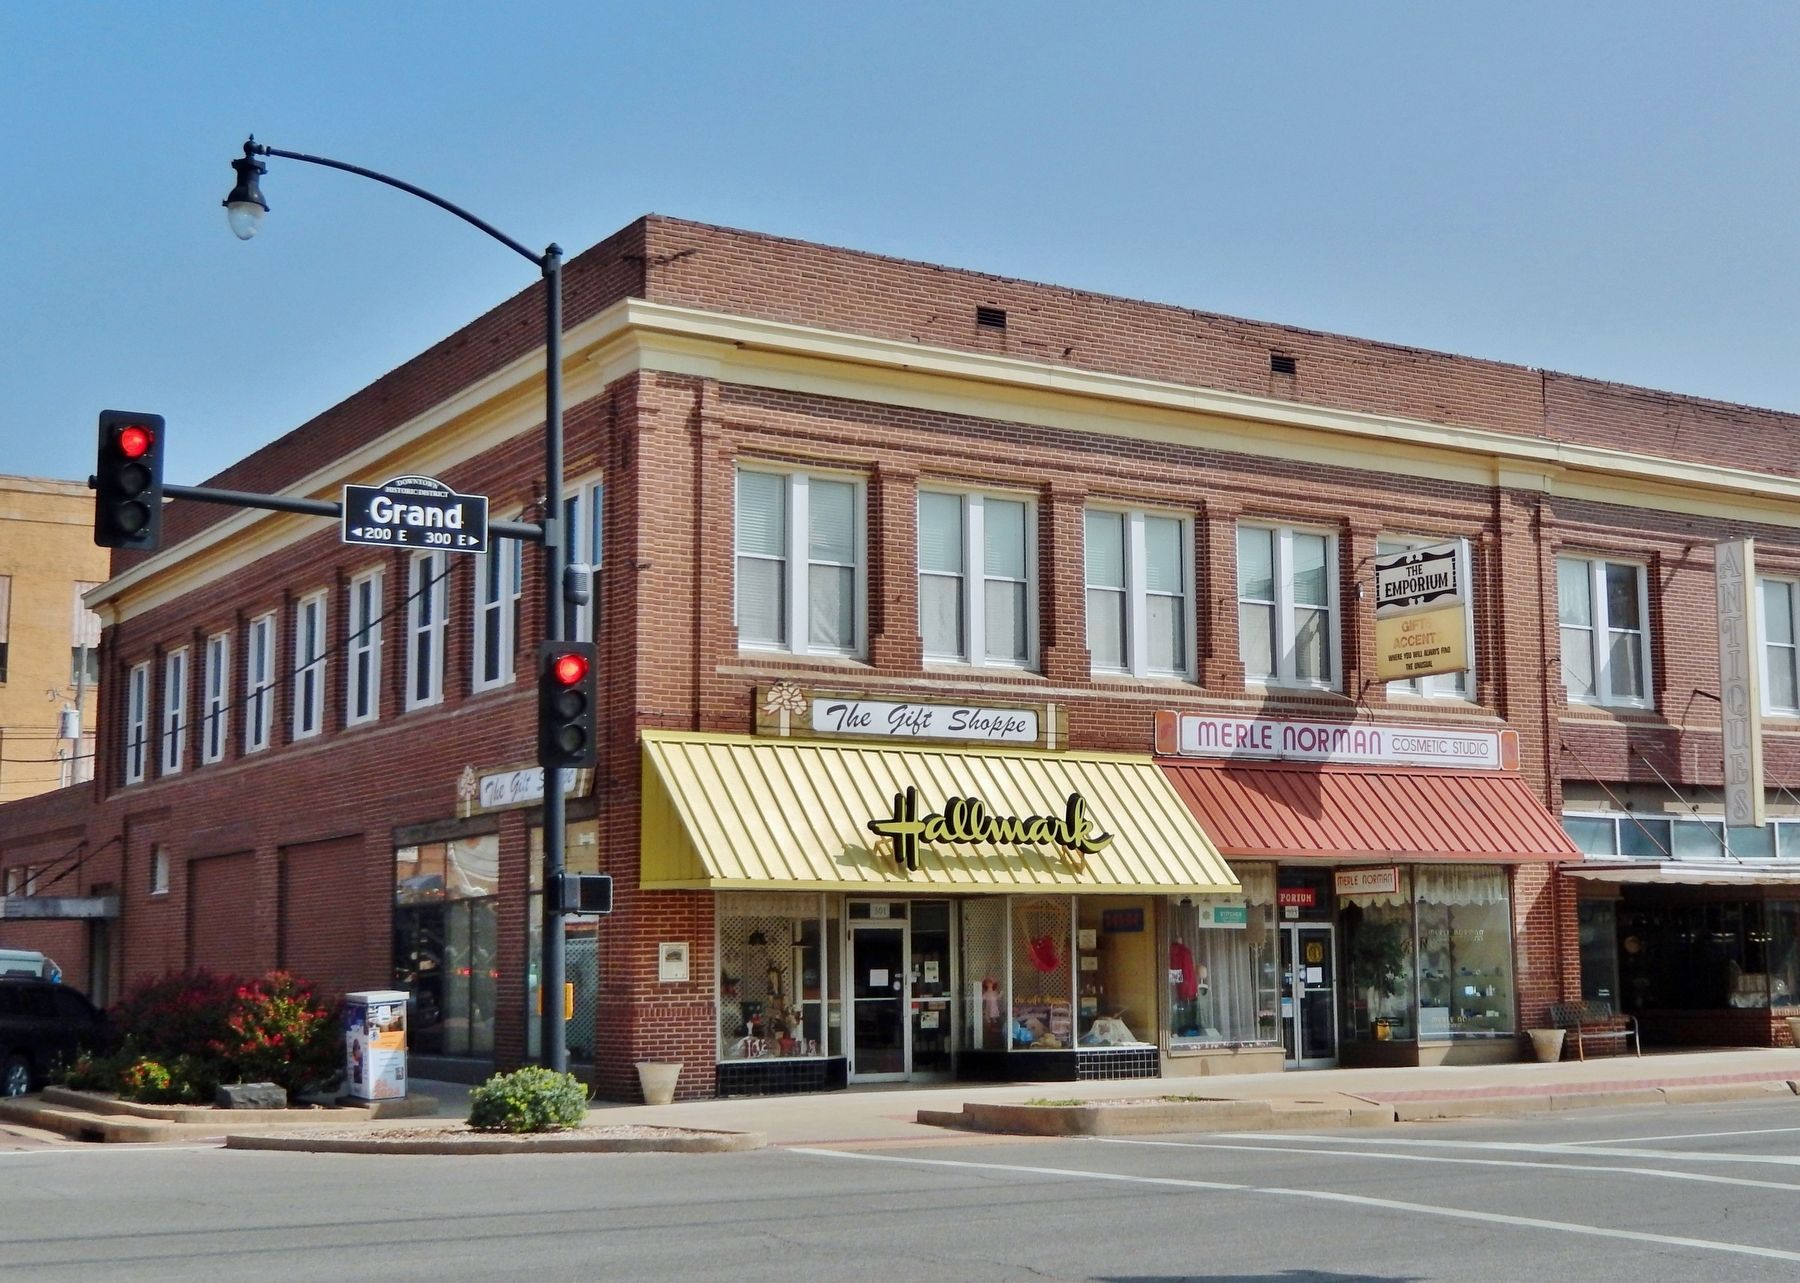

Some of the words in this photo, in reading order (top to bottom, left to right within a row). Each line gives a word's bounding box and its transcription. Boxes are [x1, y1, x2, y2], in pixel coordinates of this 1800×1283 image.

[385, 486, 418, 495] HISTORIC
[418, 489, 449, 498] DISTRICT
[396, 478, 440, 489] DOWNTOWN
[370, 496, 463, 529] Grand
[364, 527, 392, 540] 200
[398, 530, 408, 542] E
[425, 532, 452, 545] 300
[458, 534, 467, 546] E
[1385, 572, 1448, 598] EMPORIUM
[1406, 564, 1423, 577] THE
[1719, 546, 1749, 820] ANTIQUES
[826, 703, 872, 731] The
[887, 704, 933, 735] Gift
[948, 708, 1027, 737] Shoppe
[1197, 720, 1273, 750] MERLE
[1283, 725, 1383, 755] NORMAN
[1391, 737, 1448, 754] COSMETIC
[1452, 741, 1489, 756] STUDIO
[485, 777, 505, 804] The
[510, 771, 532, 801] Gift
[867, 785, 1115, 872] Hallmark
[1337, 875, 1359, 887] MERLE
[1362, 873, 1393, 885] NORMAN
